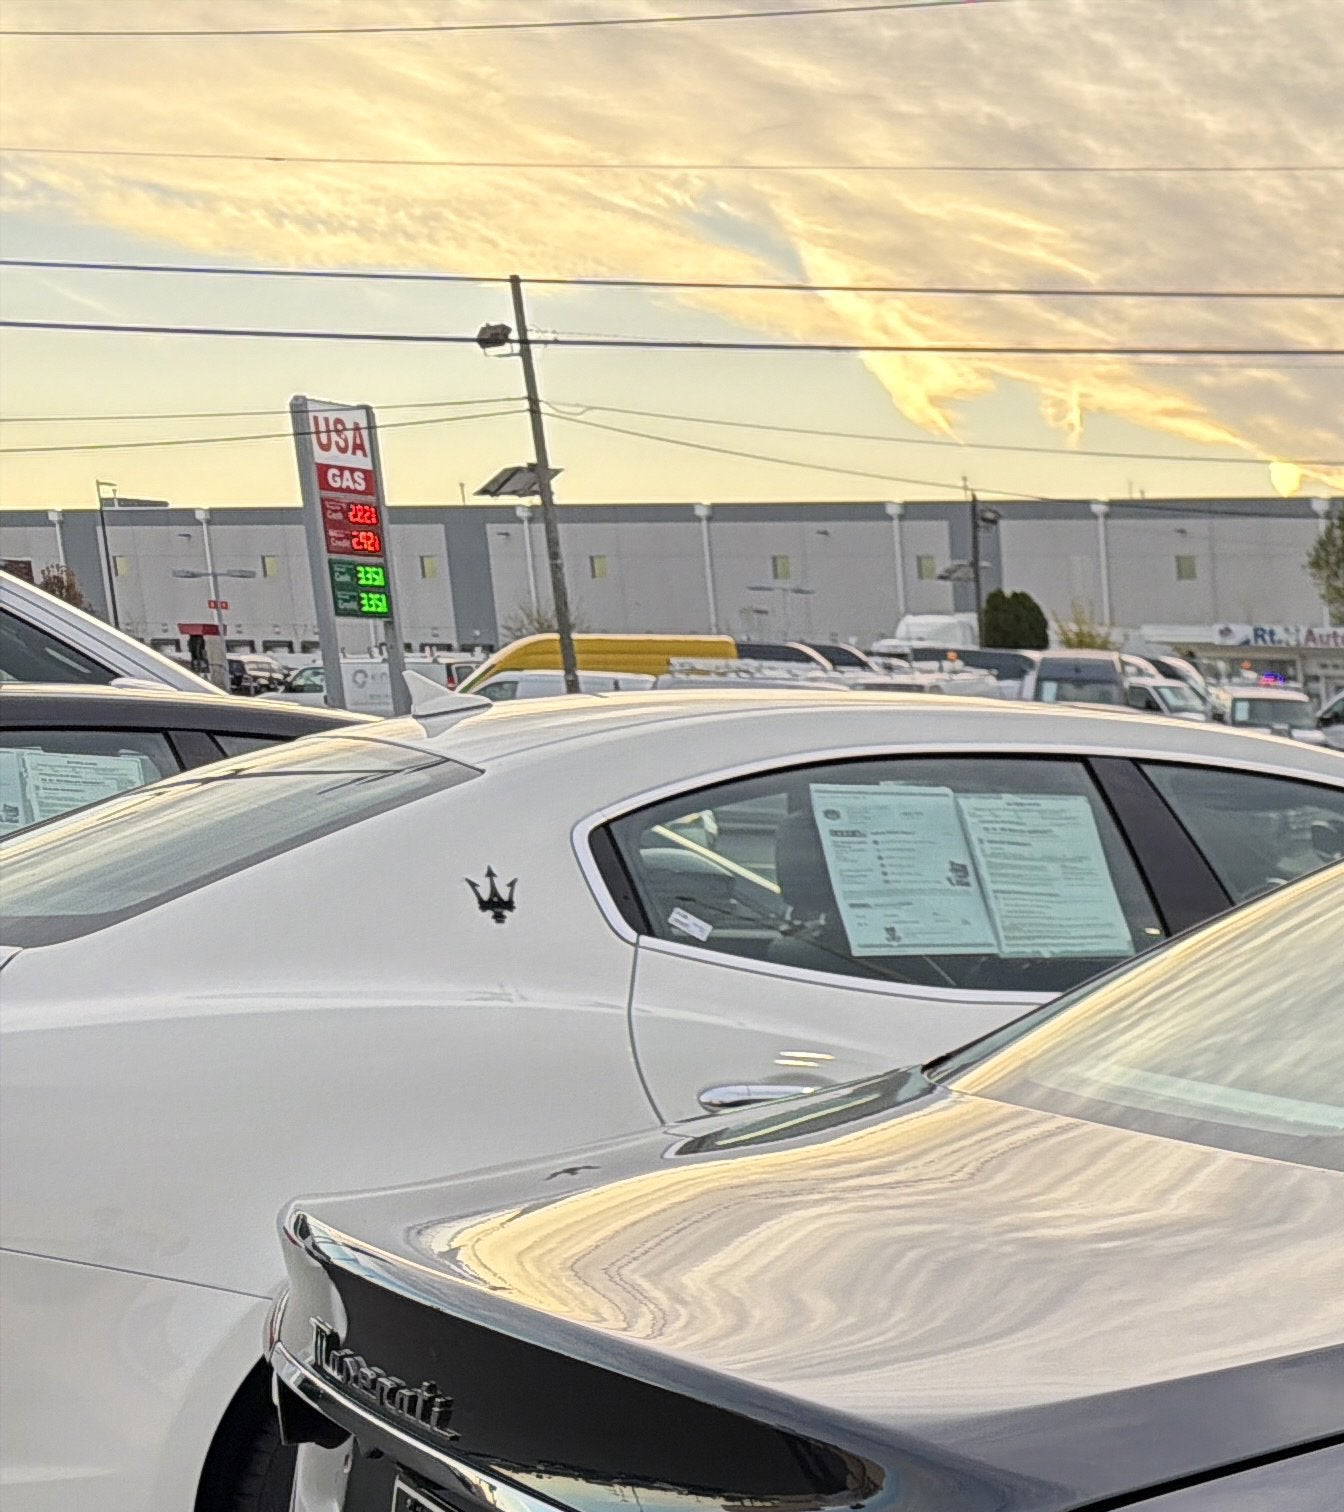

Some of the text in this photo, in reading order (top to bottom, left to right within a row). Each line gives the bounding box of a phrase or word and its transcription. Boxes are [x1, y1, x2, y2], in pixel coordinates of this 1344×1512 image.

[313, 415, 368, 458] USA
[327, 468, 366, 491] GAS
[309, 1316, 462, 1441] Maserati
